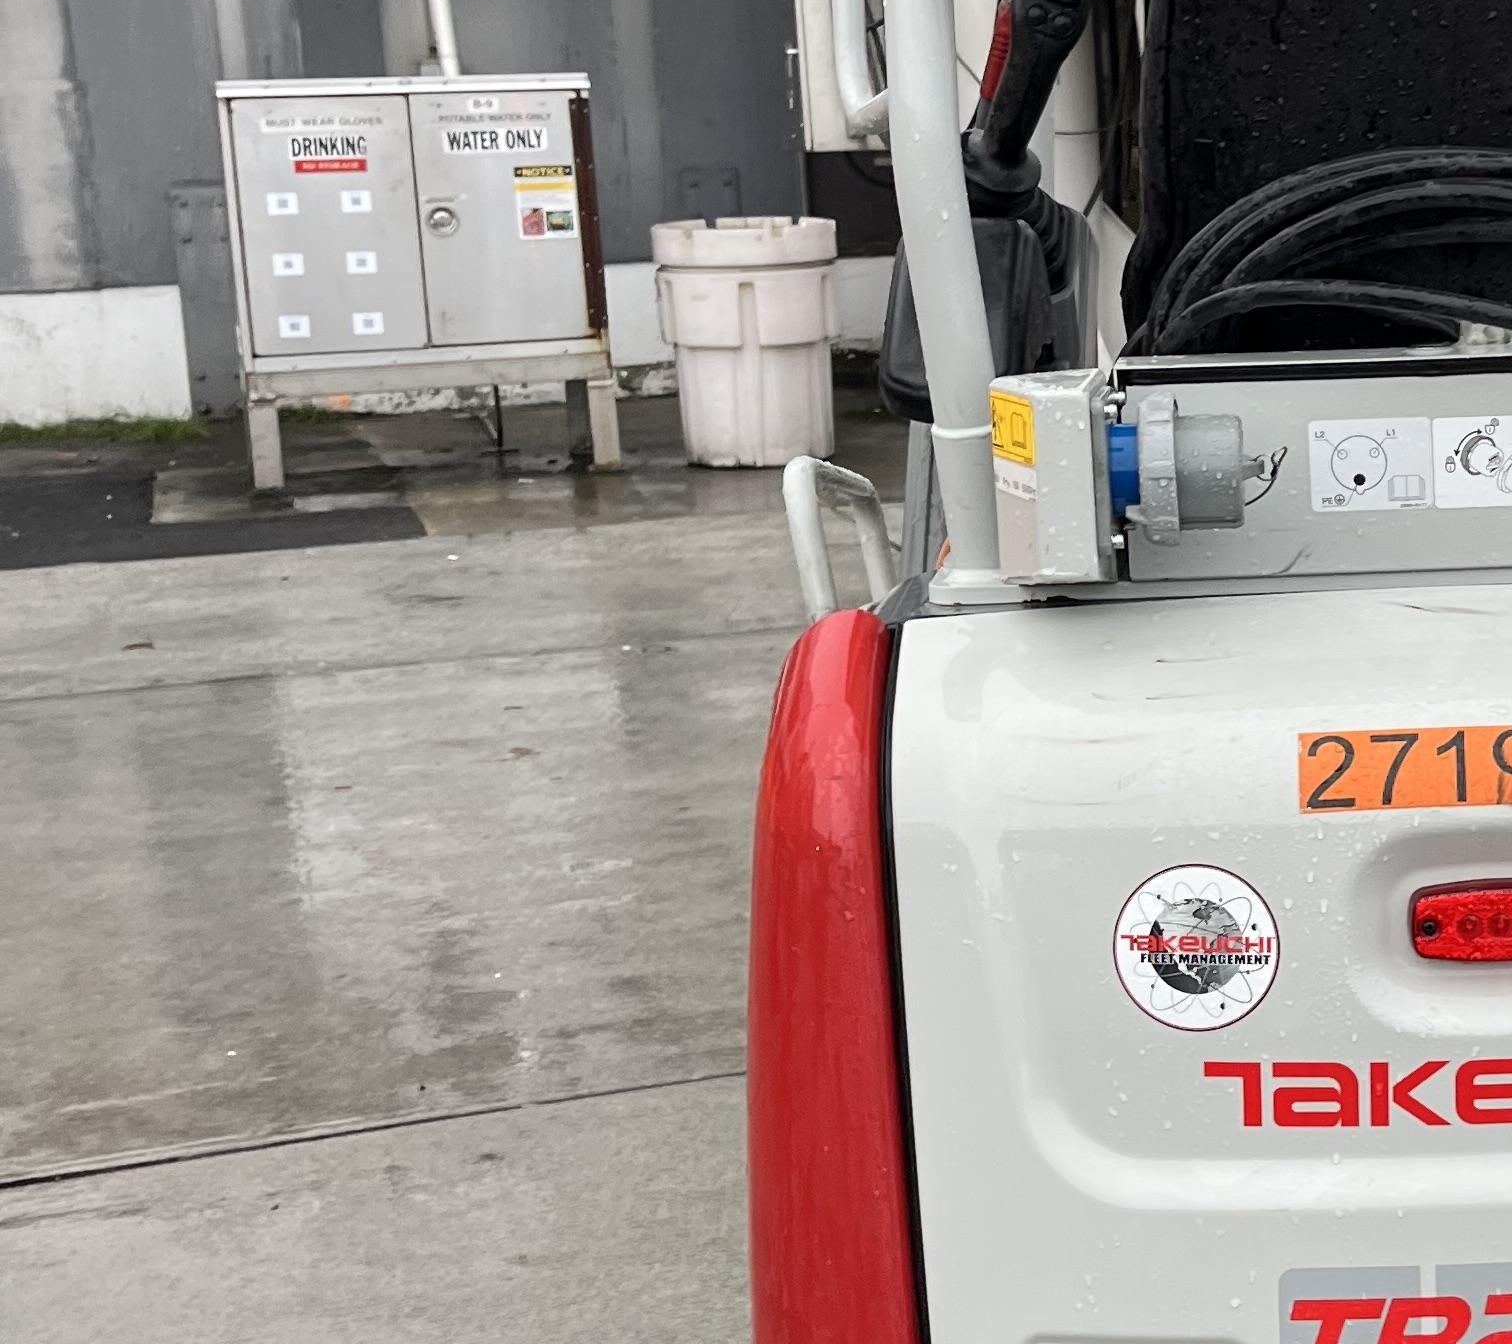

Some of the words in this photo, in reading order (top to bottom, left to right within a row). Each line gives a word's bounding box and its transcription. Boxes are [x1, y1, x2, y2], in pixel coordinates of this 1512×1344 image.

[446, 130, 500, 151] WATER
[505, 128, 544, 150] ONLY
[291, 135, 367, 157] DRINKING
[1314, 430, 1325, 439] L2
[1386, 428, 1396, 437] L1
[1321, 496, 1334, 505] PE
[1140, 953, 1175, 965] FLEET
[1178, 953, 1271, 965] MANAGEMENT
